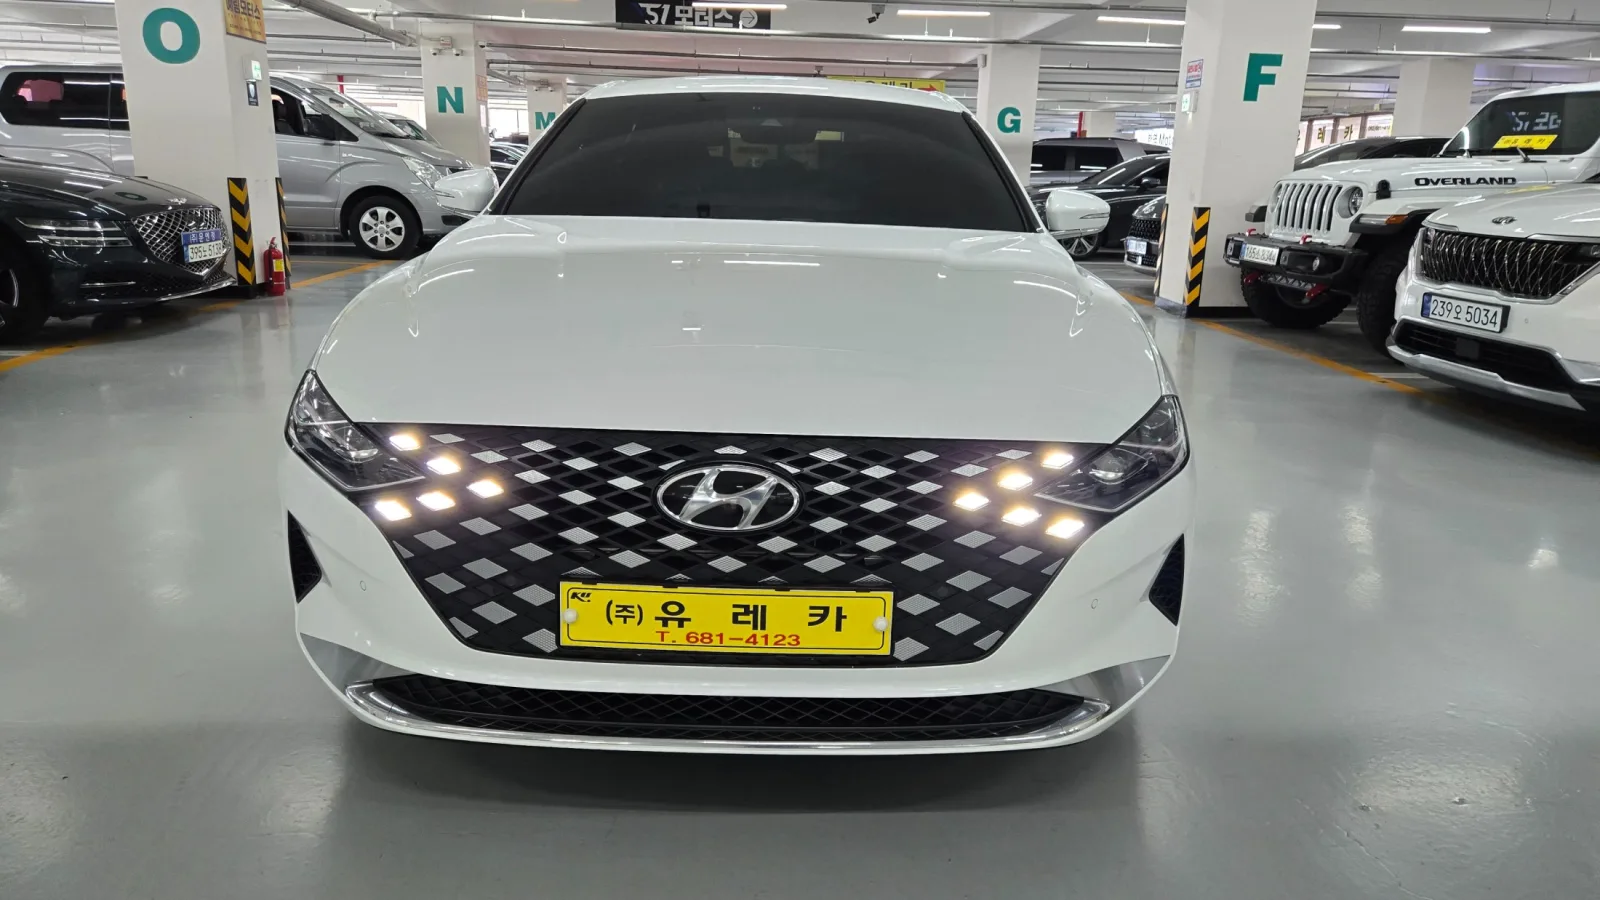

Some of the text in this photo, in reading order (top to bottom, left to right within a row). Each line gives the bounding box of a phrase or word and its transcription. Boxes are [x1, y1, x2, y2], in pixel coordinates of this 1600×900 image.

[675, 6, 733, 28] 모터스
[142, 7, 200, 64] O
[1243, 52, 1283, 102] F
[437, 86, 464, 114] N
[535, 111, 556, 130] M
[997, 106, 1021, 133] G
[1414, 177, 1517, 187] OVERLAND
[1431, 299, 1498, 328] 239오 5034
[685, 631, 801, 646] 681-4123
